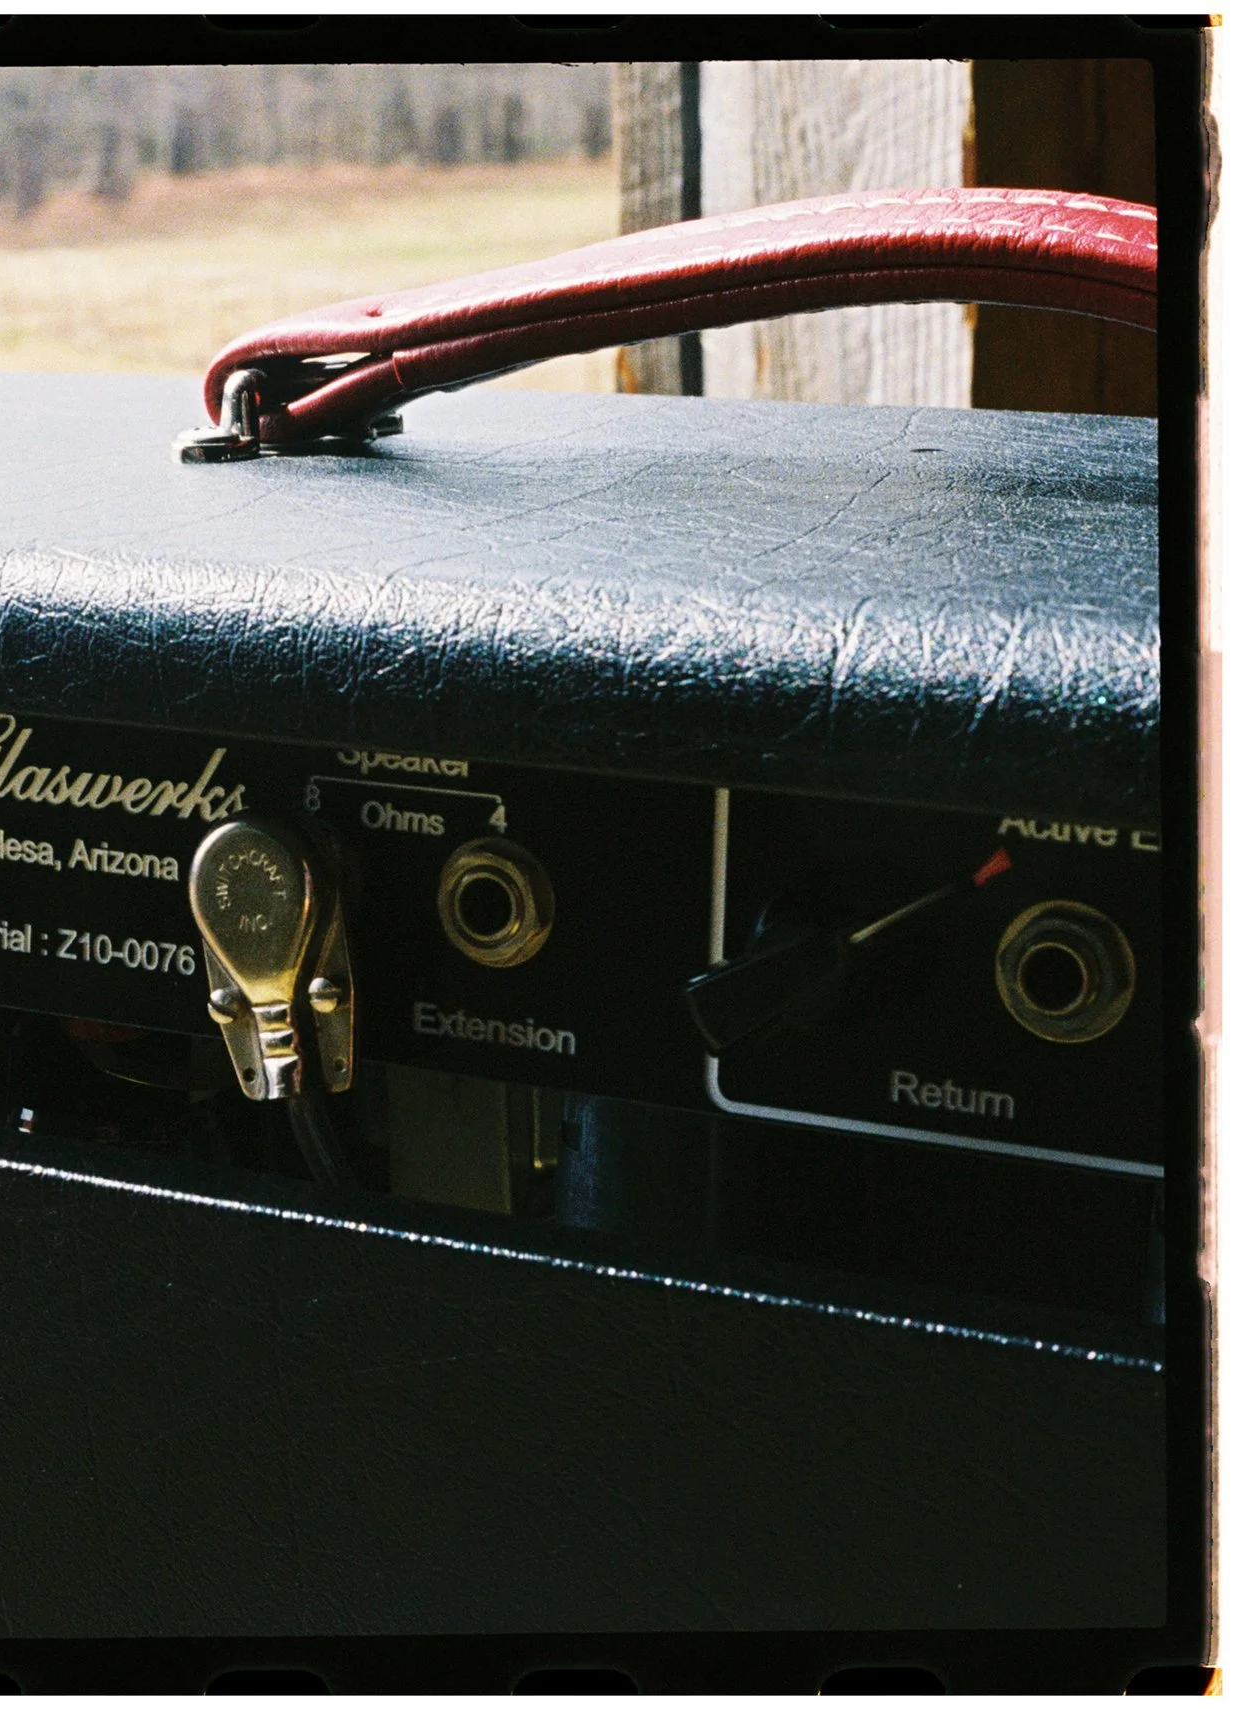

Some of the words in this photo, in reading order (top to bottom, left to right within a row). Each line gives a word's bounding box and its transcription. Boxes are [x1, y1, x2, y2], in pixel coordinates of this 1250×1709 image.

[360, 800, 446, 837] Ohms
[488, 803, 508, 834] 4
[67, 838, 180, 882] Arizona
[55, 927, 197, 976] Z10-0076
[411, 1000, 577, 1057] Extension
[889, 1069, 1016, 1121] Return
